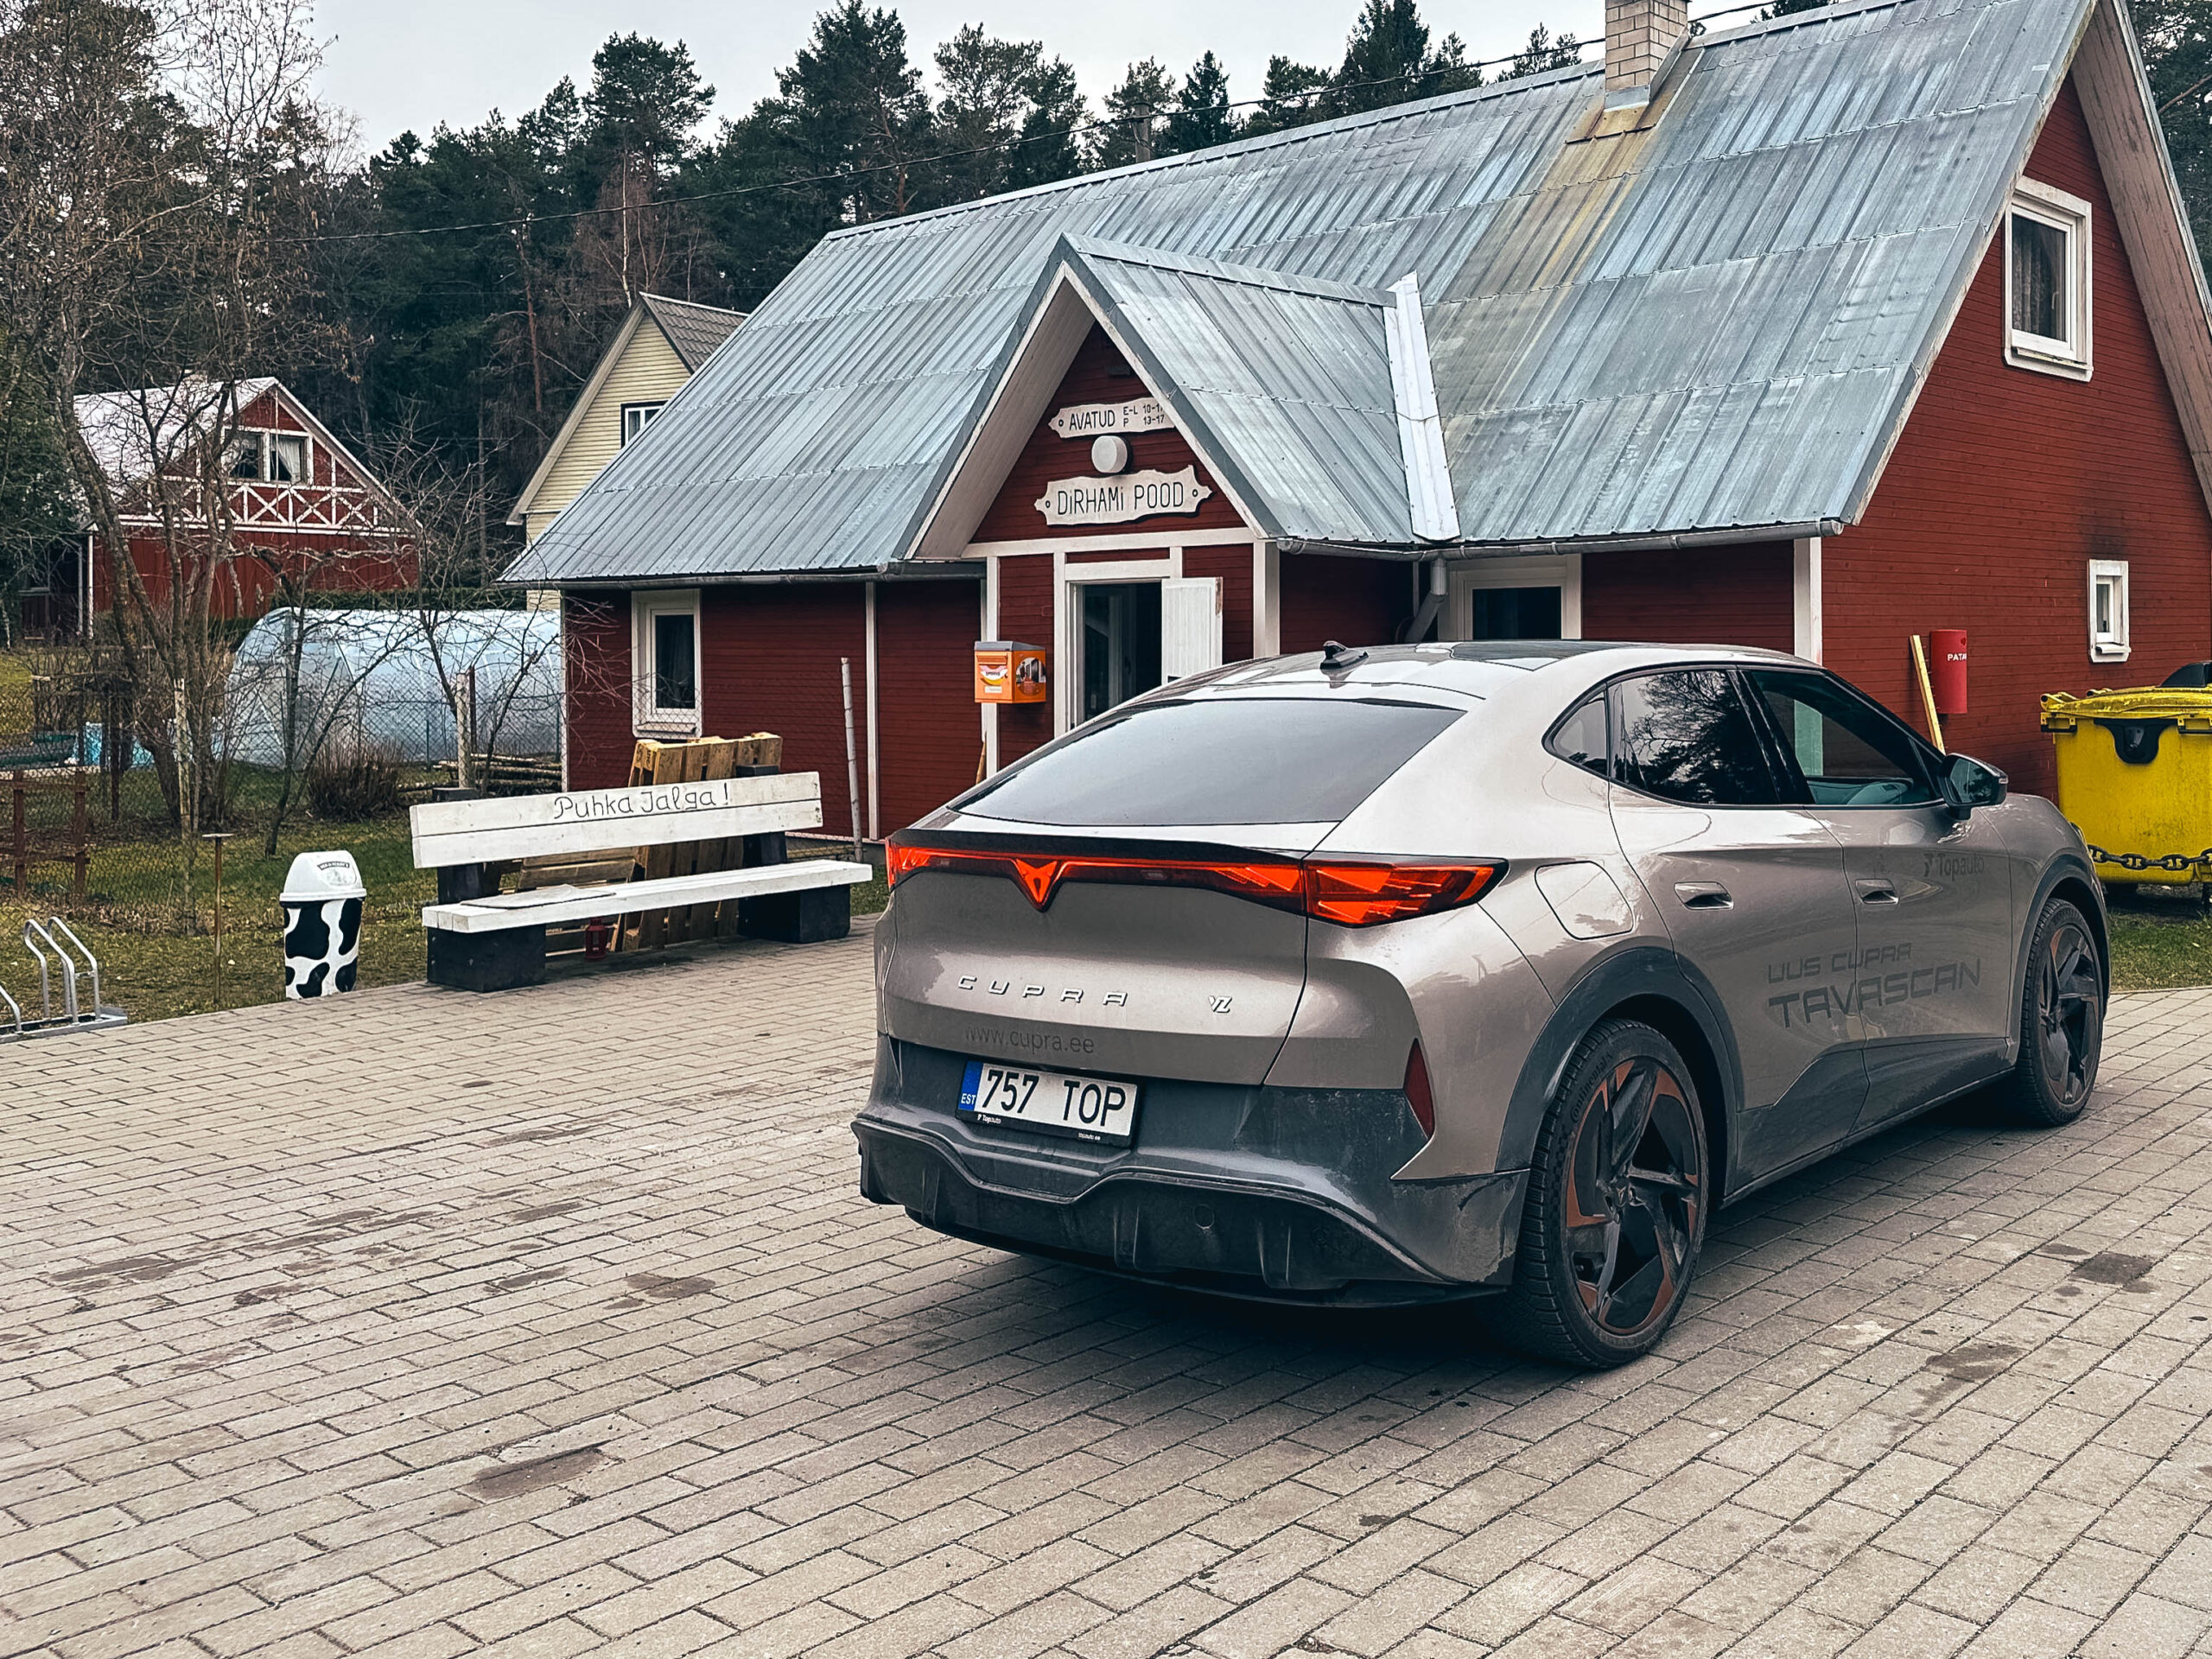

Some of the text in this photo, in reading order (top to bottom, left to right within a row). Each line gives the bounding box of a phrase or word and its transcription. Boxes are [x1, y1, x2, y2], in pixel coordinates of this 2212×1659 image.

[1069, 410, 1116, 430] AVATUD
[1123, 405, 1138, 416] E-L
[1123, 414, 1165, 428] P 13-17
[1134, 481, 1184, 511] POOD
[554, 793, 634, 820] Puhka
[1937, 854, 1986, 881] Topauto
[1768, 942, 1912, 984] UUS CUPRA
[957, 975, 1128, 1007] CUPRA
[1768, 957, 1981, 1028] TAVASCAN
[964, 1026, 1095, 1055] www.cupra.ee
[961, 1092, 976, 1106] EST
[982, 1069, 1127, 1127] 757 TOP
